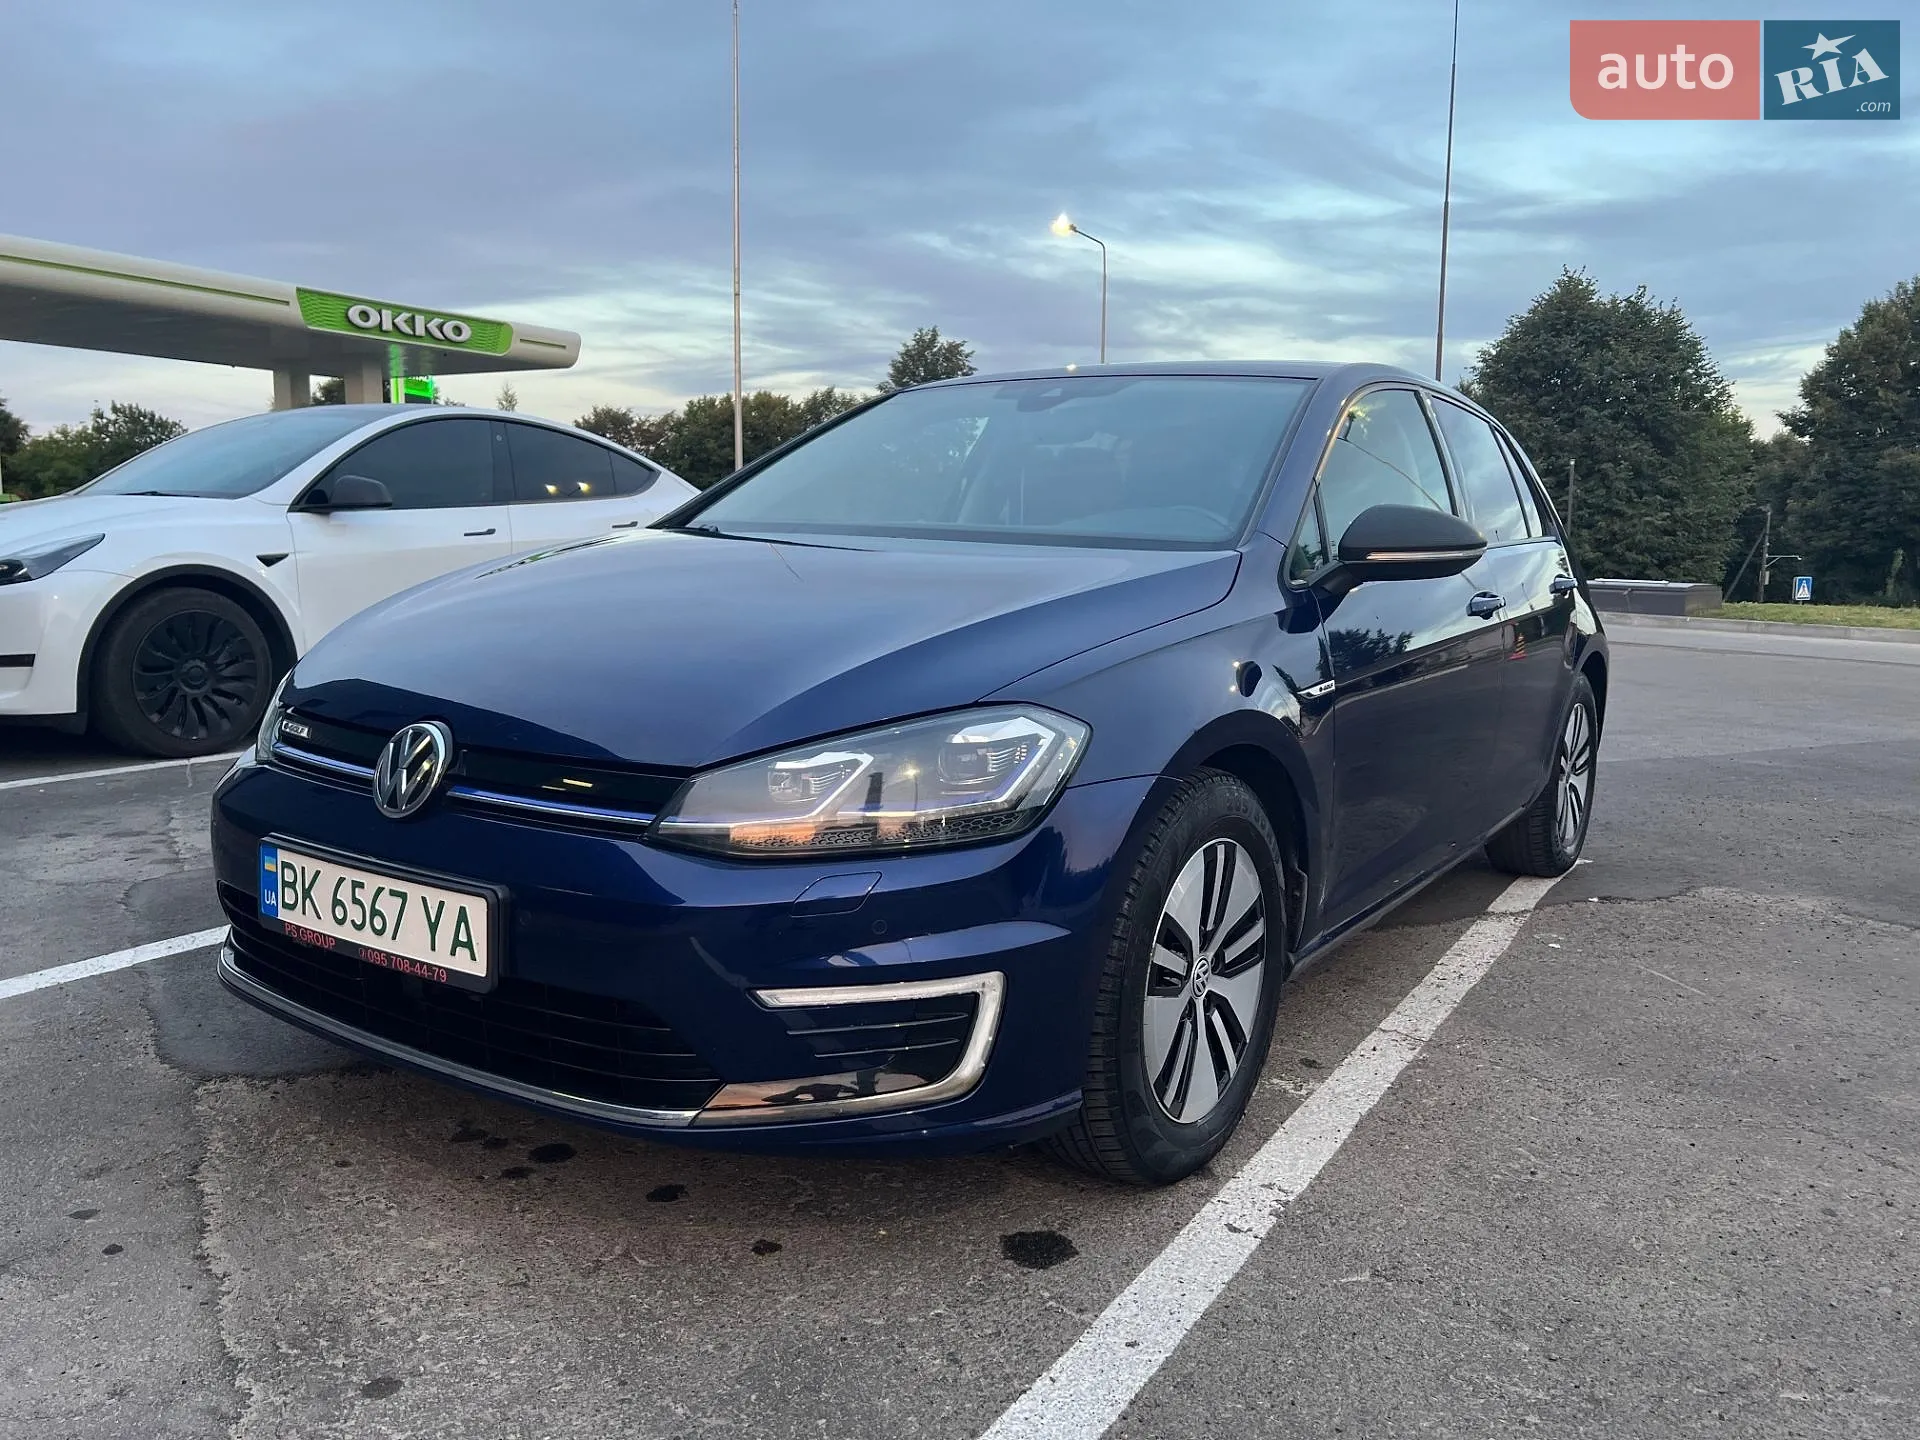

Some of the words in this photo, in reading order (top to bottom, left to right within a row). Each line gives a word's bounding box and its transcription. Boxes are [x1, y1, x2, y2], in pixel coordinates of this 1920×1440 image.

[347, 304, 472, 343] OKKO
[264, 889, 277, 907] UA
[281, 860, 322, 920] BK
[331, 876, 408, 941] 6567
[421, 896, 477, 962] YA
[284, 923, 298, 938] PS
[299, 927, 336, 950] GROUP
[367, 949, 388, 967] 095
[390, 956, 447, 983] 708-44-79
